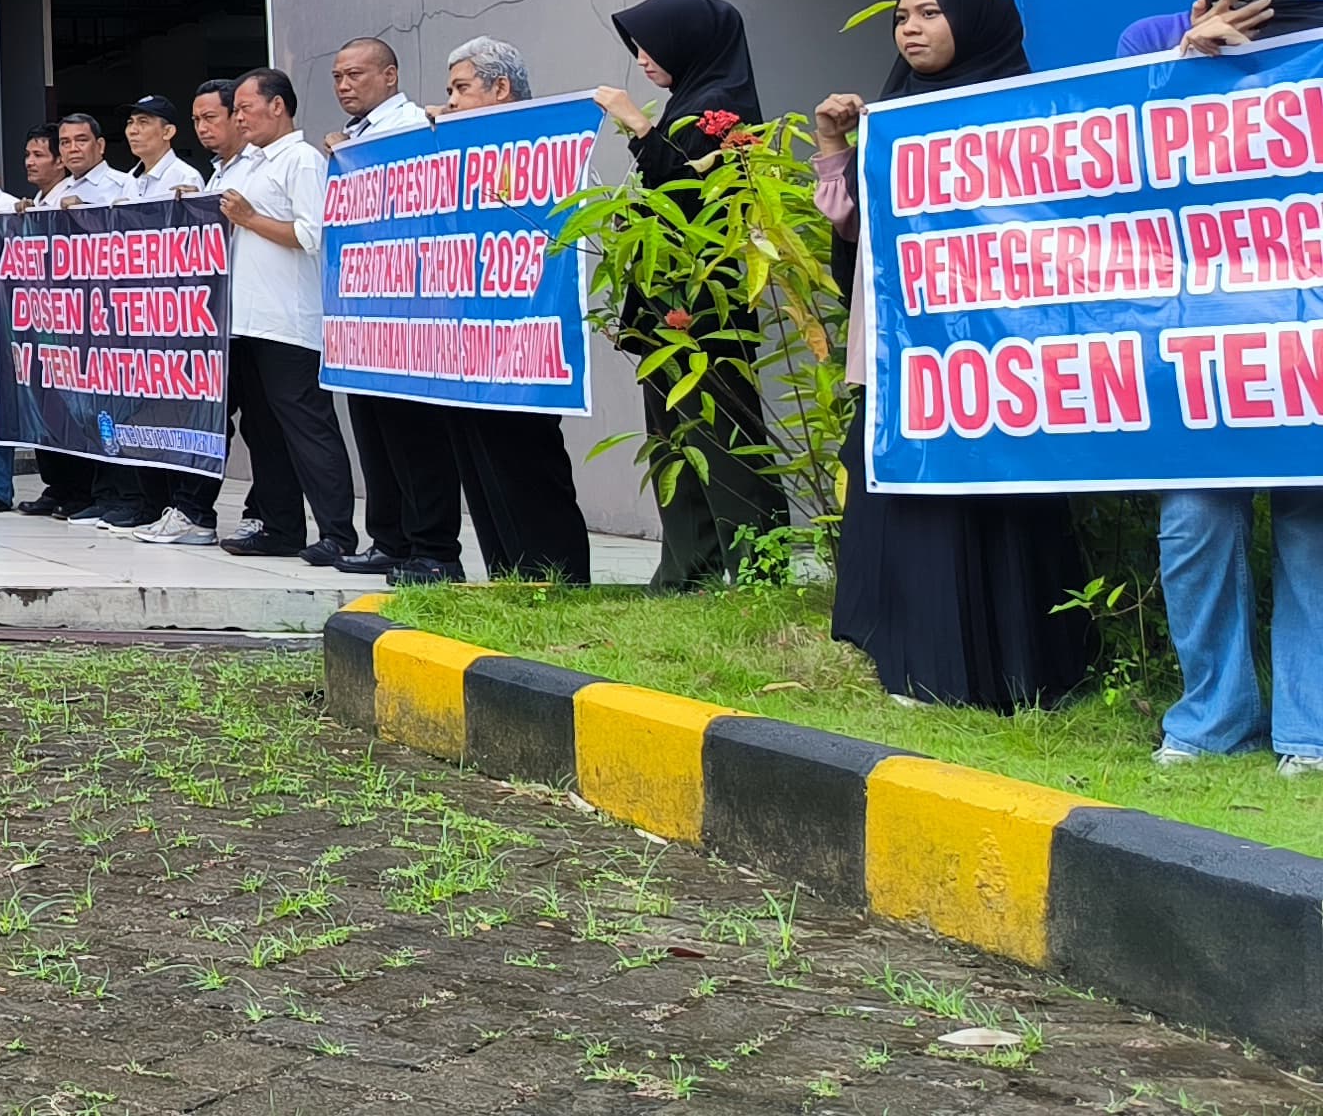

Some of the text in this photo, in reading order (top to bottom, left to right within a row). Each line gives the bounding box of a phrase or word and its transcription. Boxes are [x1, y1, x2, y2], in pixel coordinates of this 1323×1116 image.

[323, 167, 384, 223] DESKRESI
[385, 152, 458, 215] PRESIDEN
[896, 114, 1134, 210] DESKRESI
[0, 226, 228, 279] ASET DINEGERIKAN
[339, 235, 546, 295] TERBITKAN TAHUN 2025
[900, 216, 1175, 310] PENEGERIAN
[13, 288, 217, 335] DOSEN & TENDIK
[39, 346, 224, 400] TERLANTARKAN
[435, 323, 460, 374] PARA
[461, 322, 491, 377] SDM
[907, 339, 1143, 432] DOSEN
